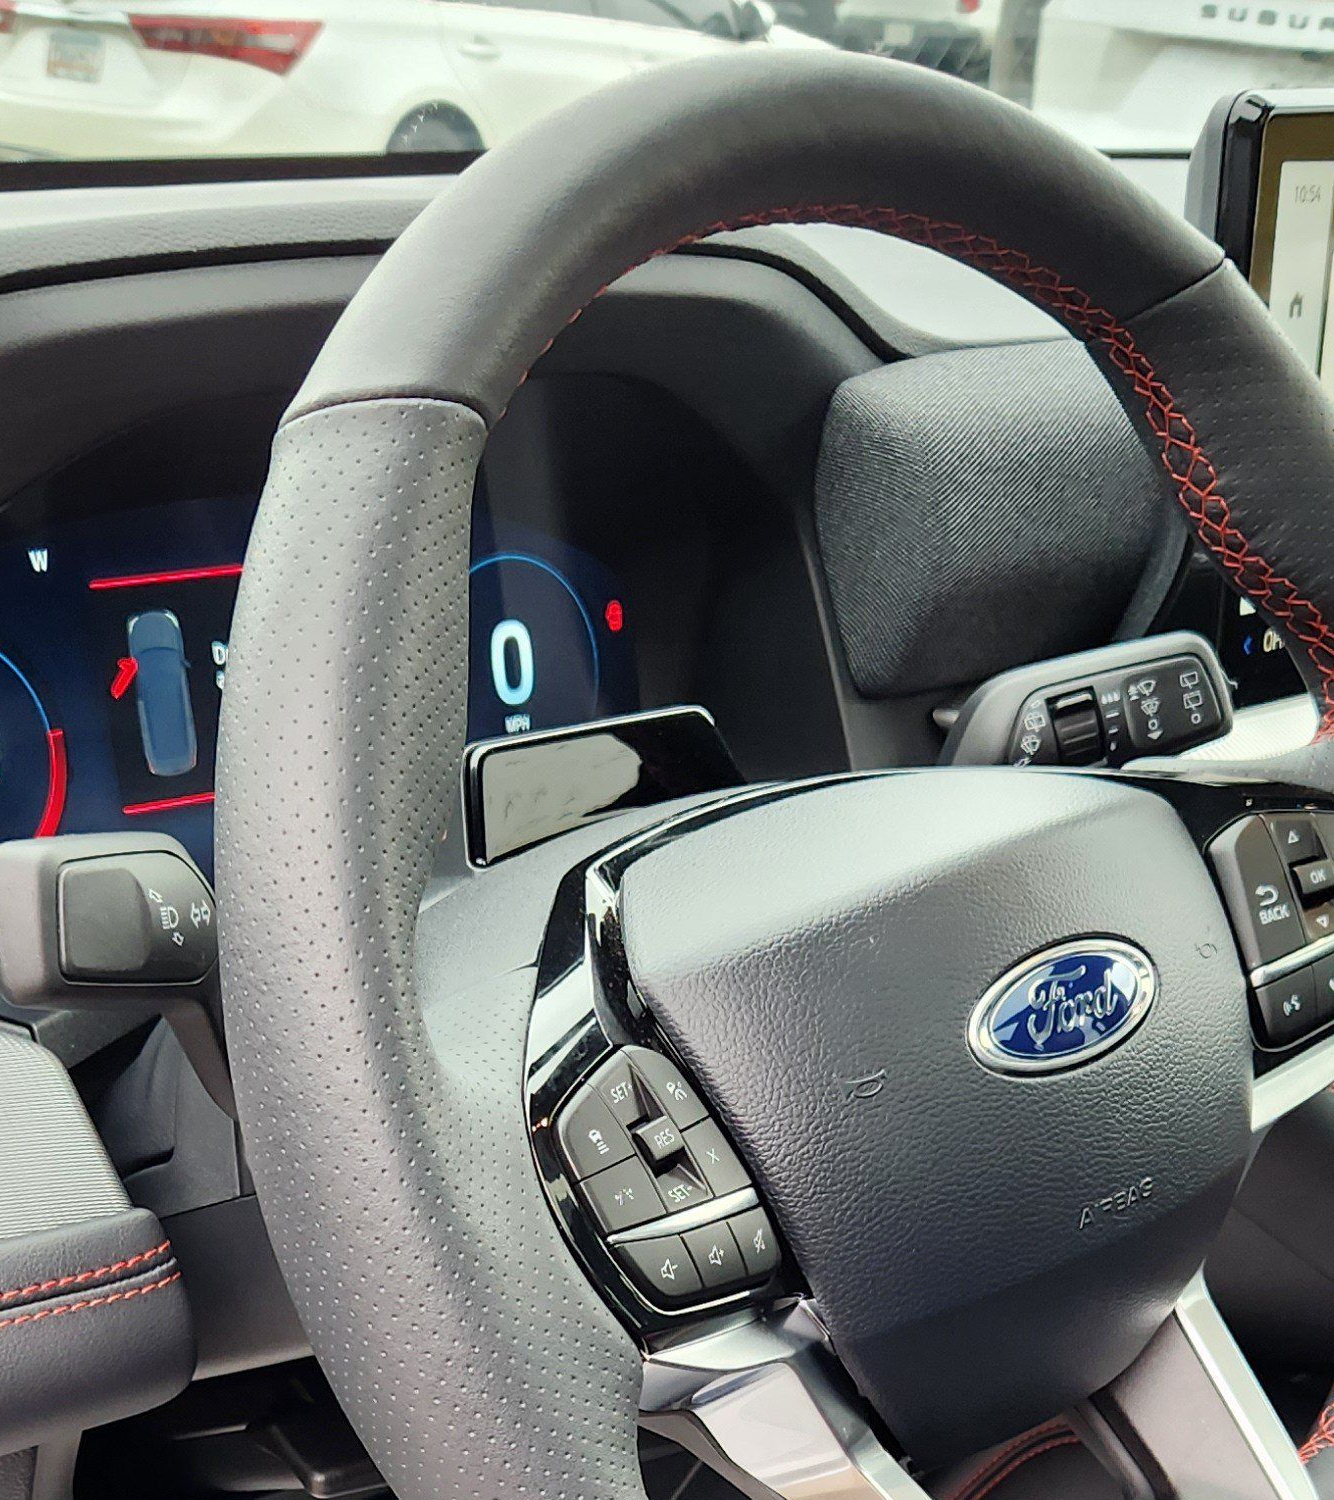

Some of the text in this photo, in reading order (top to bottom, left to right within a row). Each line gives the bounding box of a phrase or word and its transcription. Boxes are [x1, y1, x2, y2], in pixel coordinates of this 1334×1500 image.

[27, 548, 48, 572] W
[490, 618, 534, 706] 0
[504, 713, 532, 735] MPH
[1309, 867, 1327, 885] OK
[1258, 904, 1291, 926] BACK
[1027, 964, 1119, 1050] Ford
[653, 1128, 676, 1150] RES
